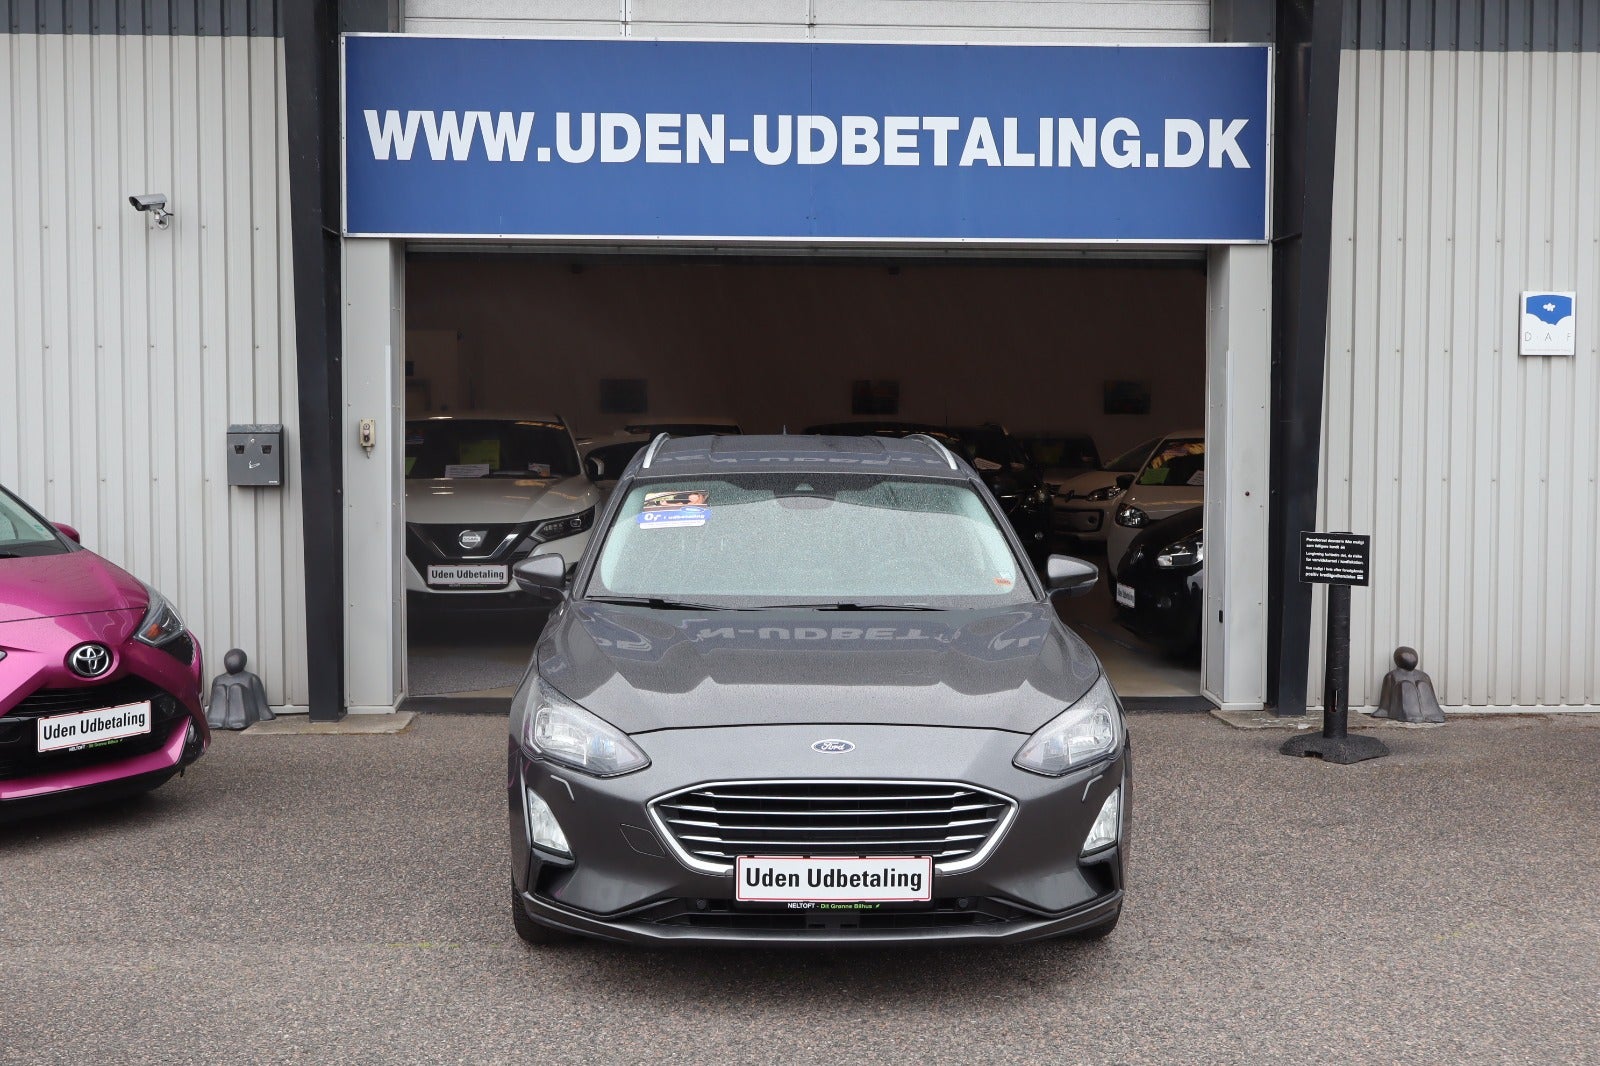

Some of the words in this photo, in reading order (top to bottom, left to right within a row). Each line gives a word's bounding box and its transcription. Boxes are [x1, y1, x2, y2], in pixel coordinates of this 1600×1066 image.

[363, 109, 1251, 169] WWW.UDEN-UDBETALING.DK
[431, 570, 454, 579] Uden
[457, 570, 504, 580] Udbetaling
[43, 724, 76, 740] Uden
[80, 712, 145, 734] Udbetaling
[821, 742, 846, 750] Ford
[746, 868, 800, 887] Uden
[807, 868, 922, 892] Udbetaling
